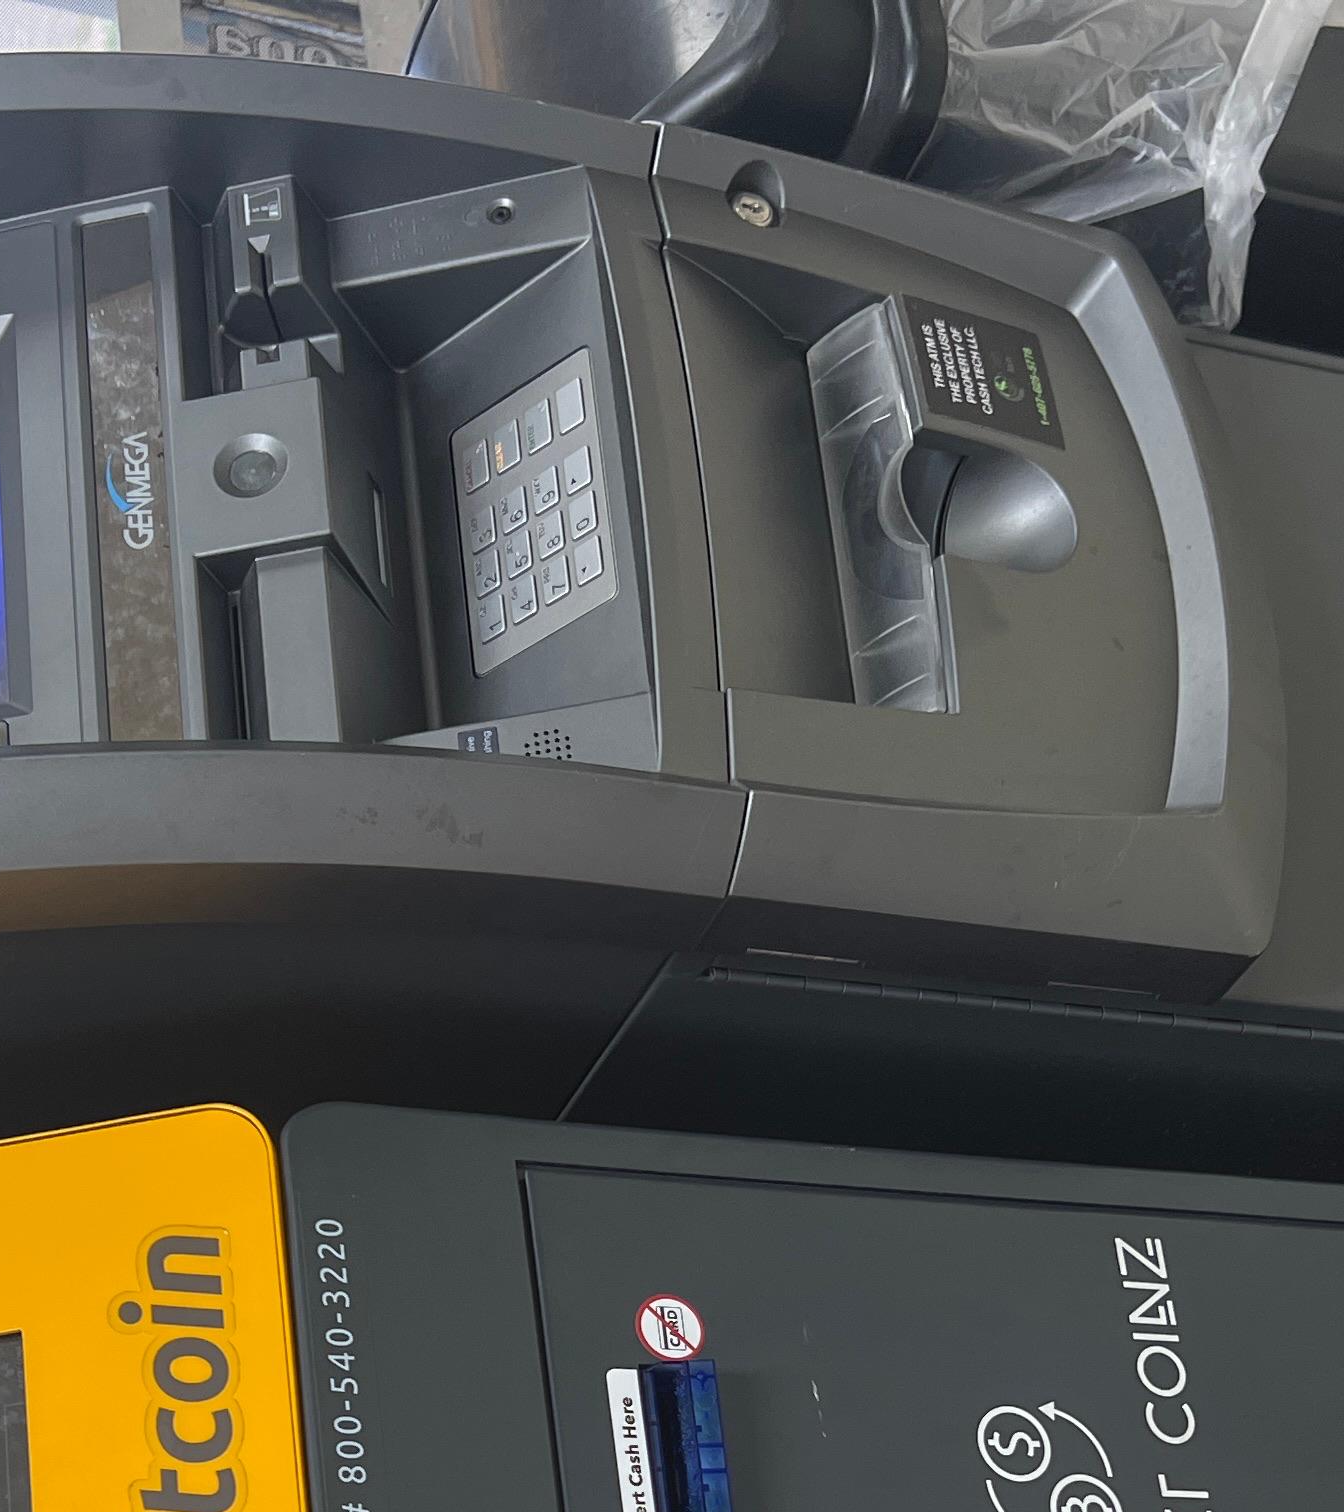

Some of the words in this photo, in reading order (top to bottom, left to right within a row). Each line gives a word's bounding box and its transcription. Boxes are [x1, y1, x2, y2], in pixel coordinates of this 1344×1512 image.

[920, 323, 934, 337] IS
[949, 325, 963, 343] OF
[924, 337, 940, 362] ATM
[933, 318, 958, 379] EXCLUSIVE
[930, 362, 946, 388] THIS
[955, 343, 978, 404] PROPERTY
[969, 350, 986, 380] TECH
[948, 379, 963, 403] THE
[977, 381, 994, 415] CASH
[121, 431, 155, 550] GENMEGA
[541, 489, 556, 504] 9
[509, 508, 524, 523] 6
[575, 517, 590, 533] 0
[478, 529, 492, 543] 3
[546, 535, 561, 549] 8
[514, 554, 529, 569] 5
[483, 571, 497, 588] 2
[551, 582, 566, 595] 7
[519, 598, 533, 611] 4
[489, 620, 501, 631] 1
[666, 1309, 681, 1348] CARD
[1114, 1236, 1196, 1445] COINZ
[313, 1218, 368, 1484] 800-540-3220
[620, 1396, 638, 1439] Here
[626, 1444, 644, 1487] Cash
